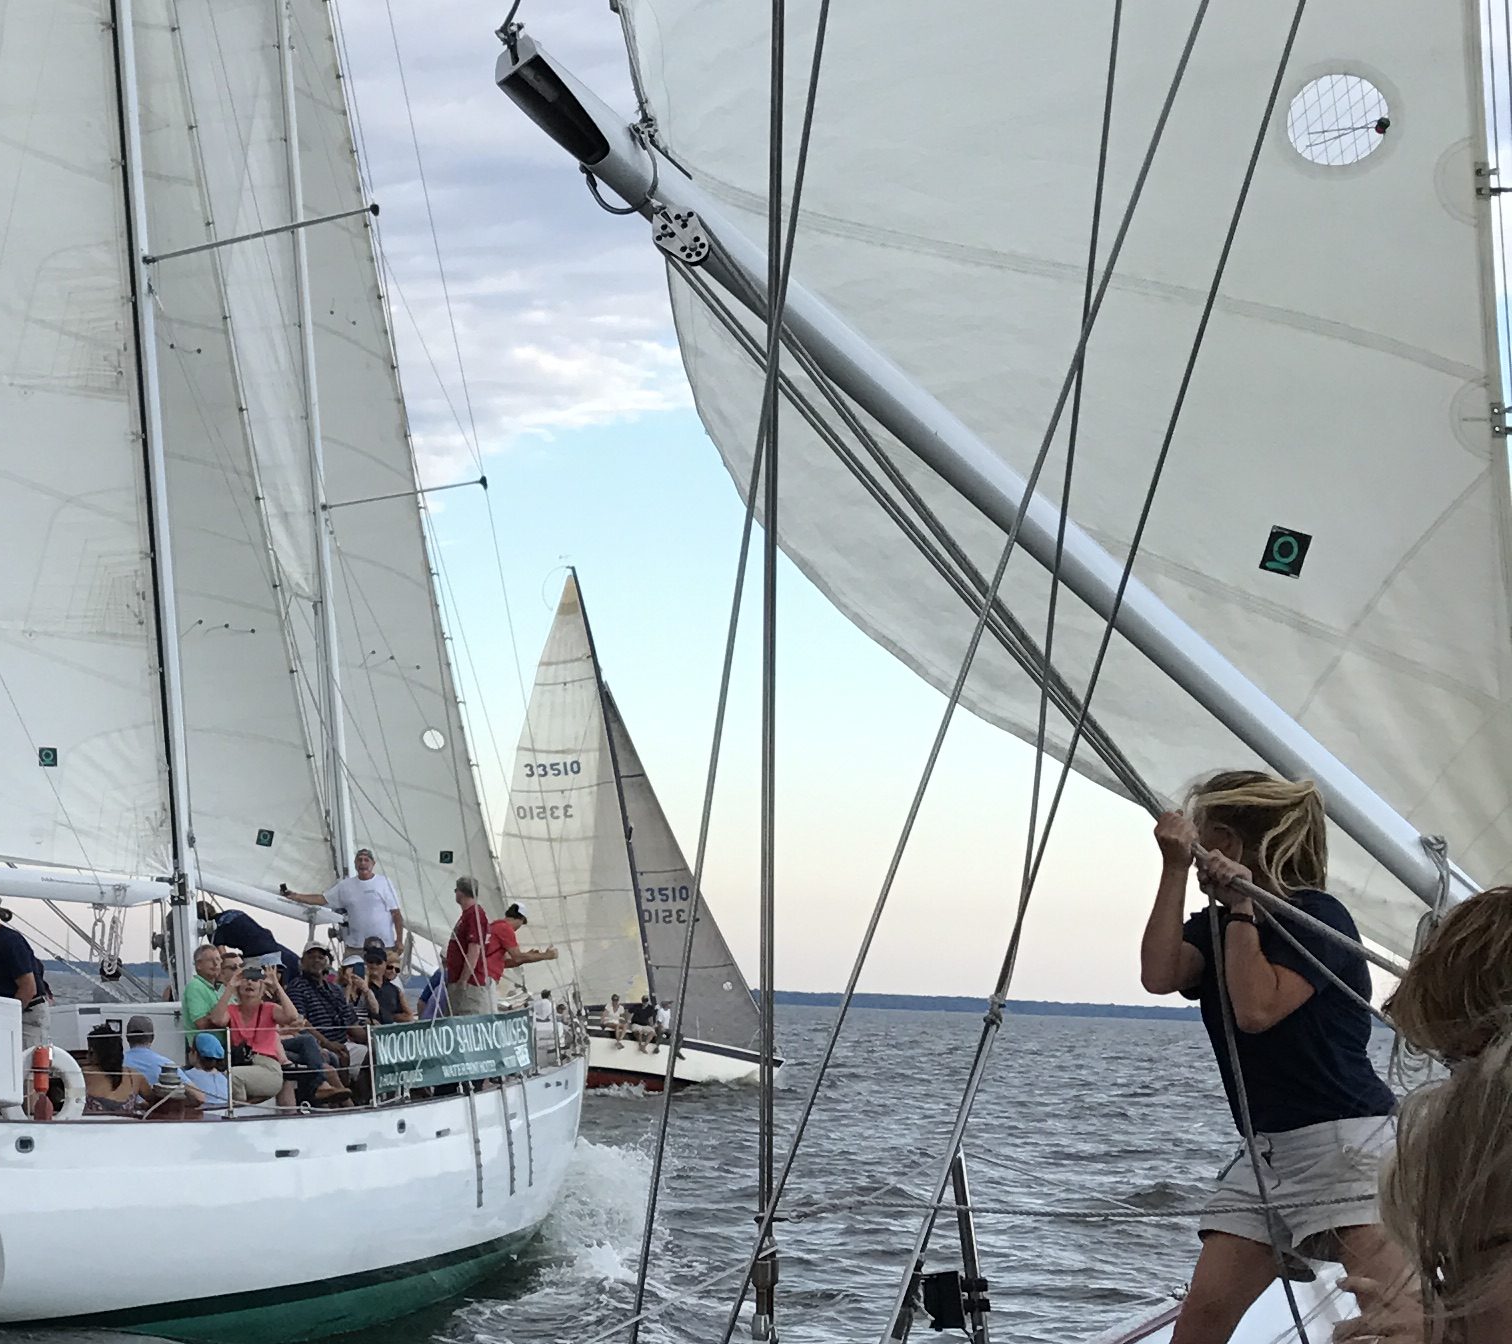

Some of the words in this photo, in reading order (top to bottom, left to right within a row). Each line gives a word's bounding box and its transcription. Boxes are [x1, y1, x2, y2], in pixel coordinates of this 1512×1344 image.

[524, 760, 581, 778] 33510
[638, 885, 690, 903] 3510
[376, 1025, 455, 1065] WOODWIND
